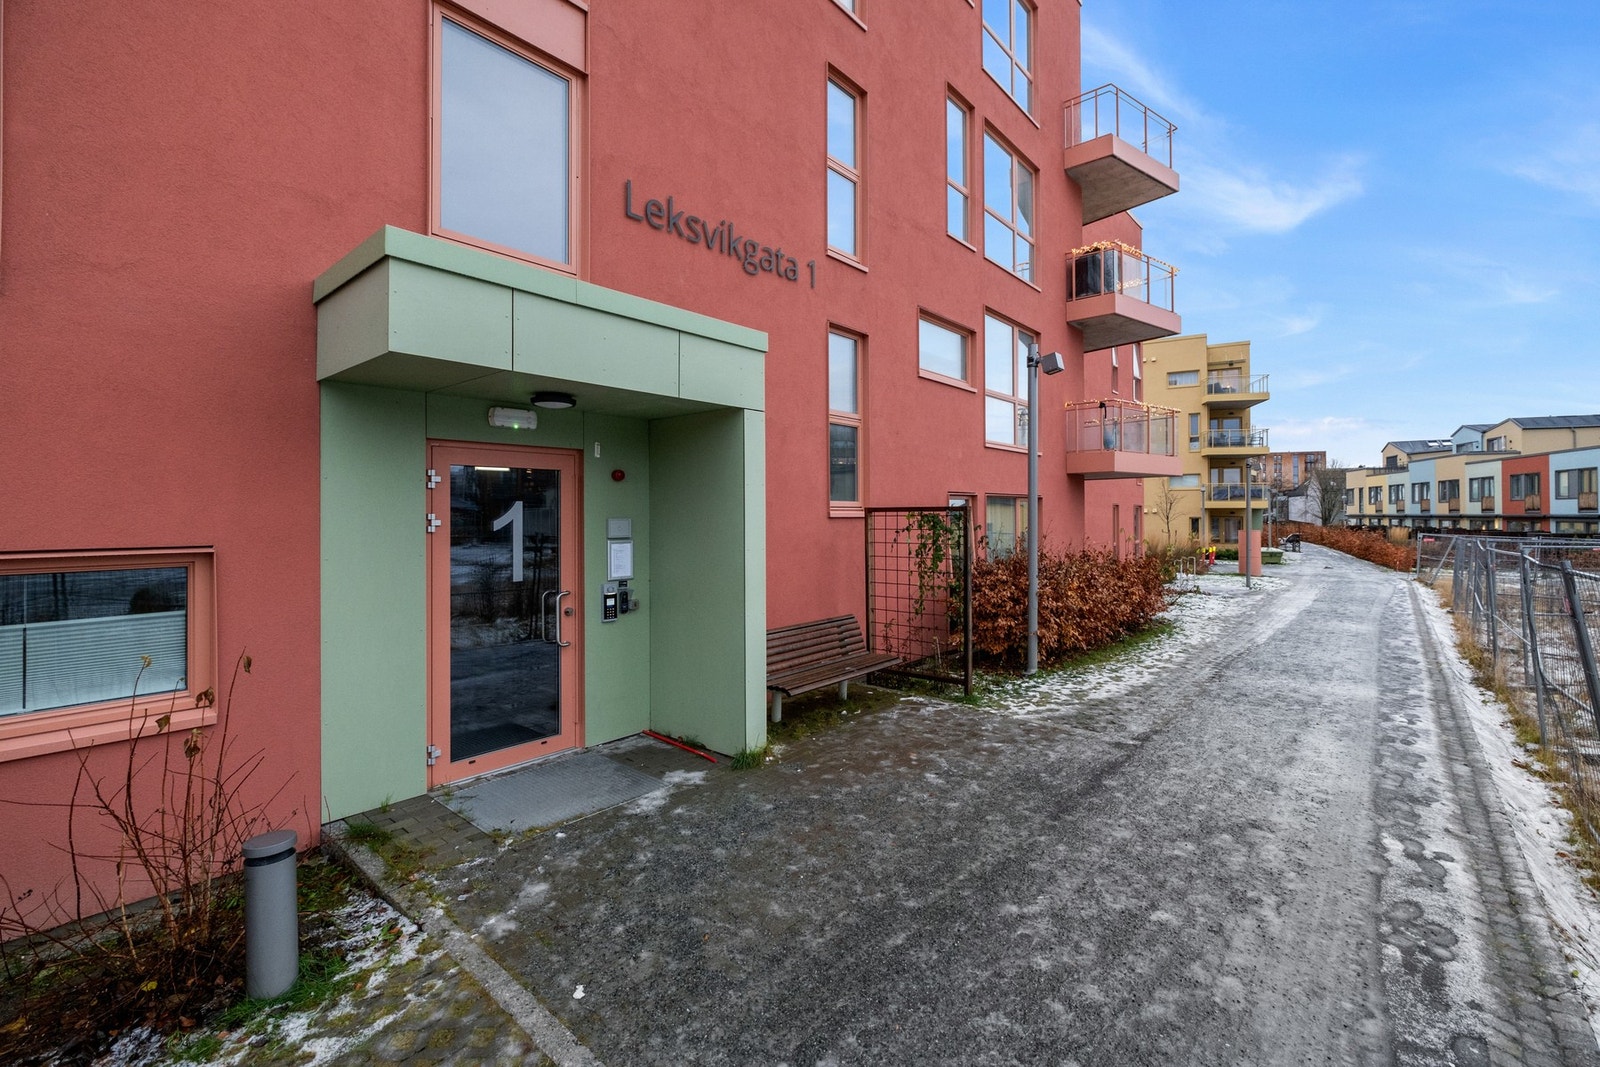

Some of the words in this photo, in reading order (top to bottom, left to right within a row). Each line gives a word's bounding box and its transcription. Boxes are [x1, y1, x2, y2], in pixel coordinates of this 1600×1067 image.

[624, 179, 799, 281] Leksvikgata
[807, 260, 816, 289] 1
[493, 501, 523, 582] 1
